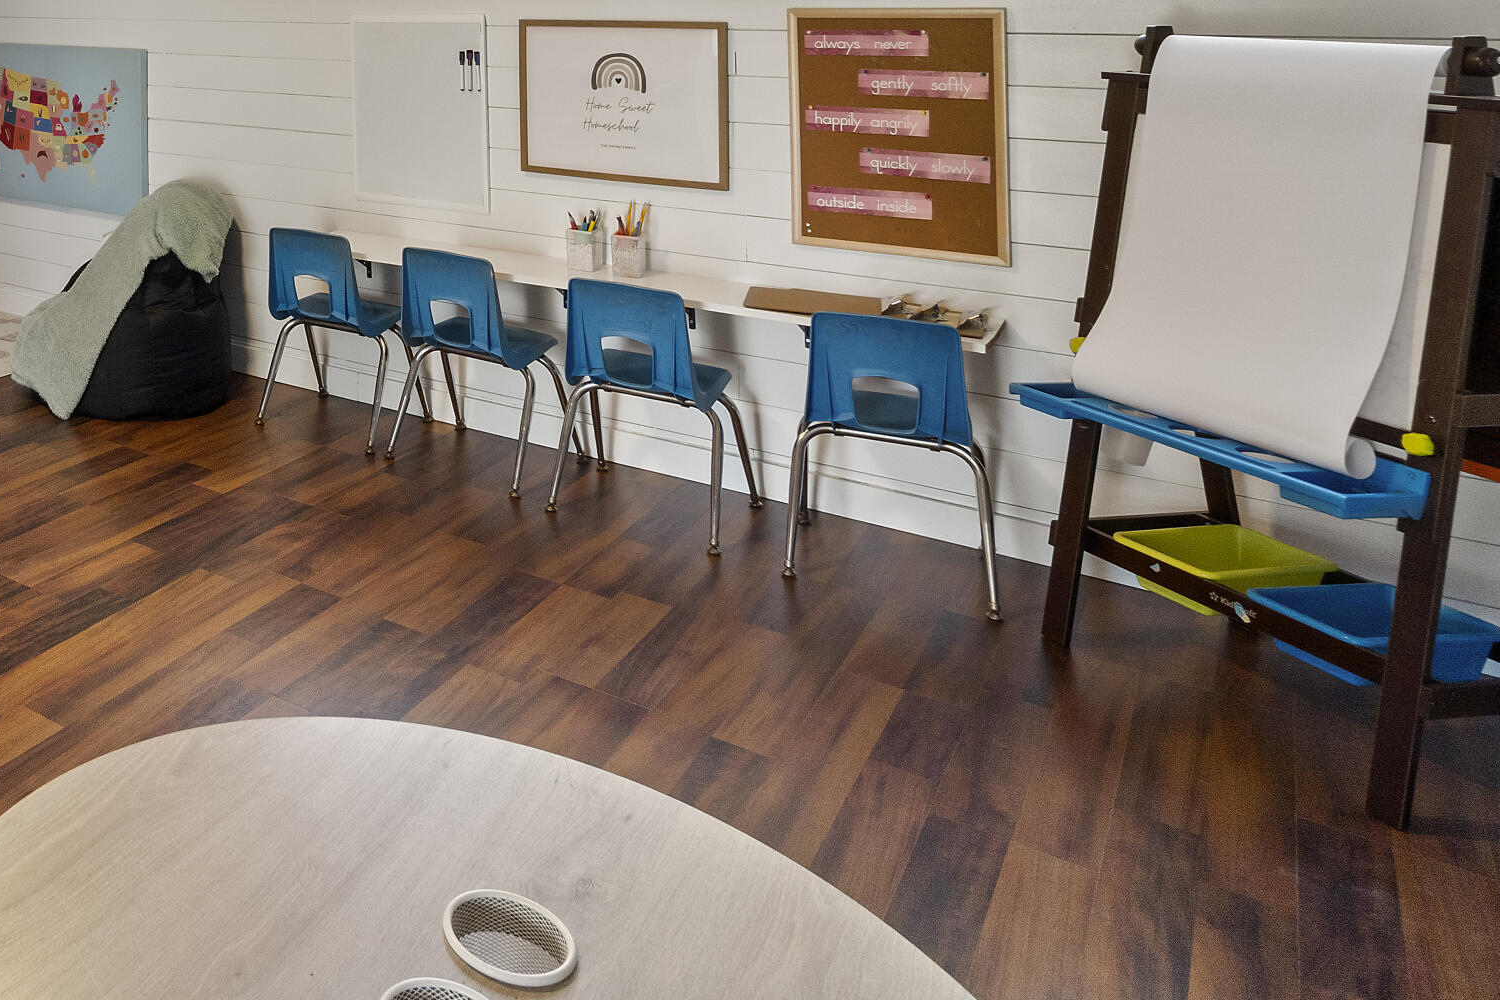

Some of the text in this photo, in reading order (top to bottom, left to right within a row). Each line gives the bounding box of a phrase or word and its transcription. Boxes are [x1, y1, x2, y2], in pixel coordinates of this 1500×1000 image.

[814, 34, 913, 56] always never
[871, 74, 973, 99] gently softly
[584, 96, 656, 114] Home Sweet
[582, 115, 640, 133] Homeschool
[814, 110, 918, 136] happily angrily
[870, 155, 976, 182] quickly slowly
[816, 194, 917, 214] outside inside
